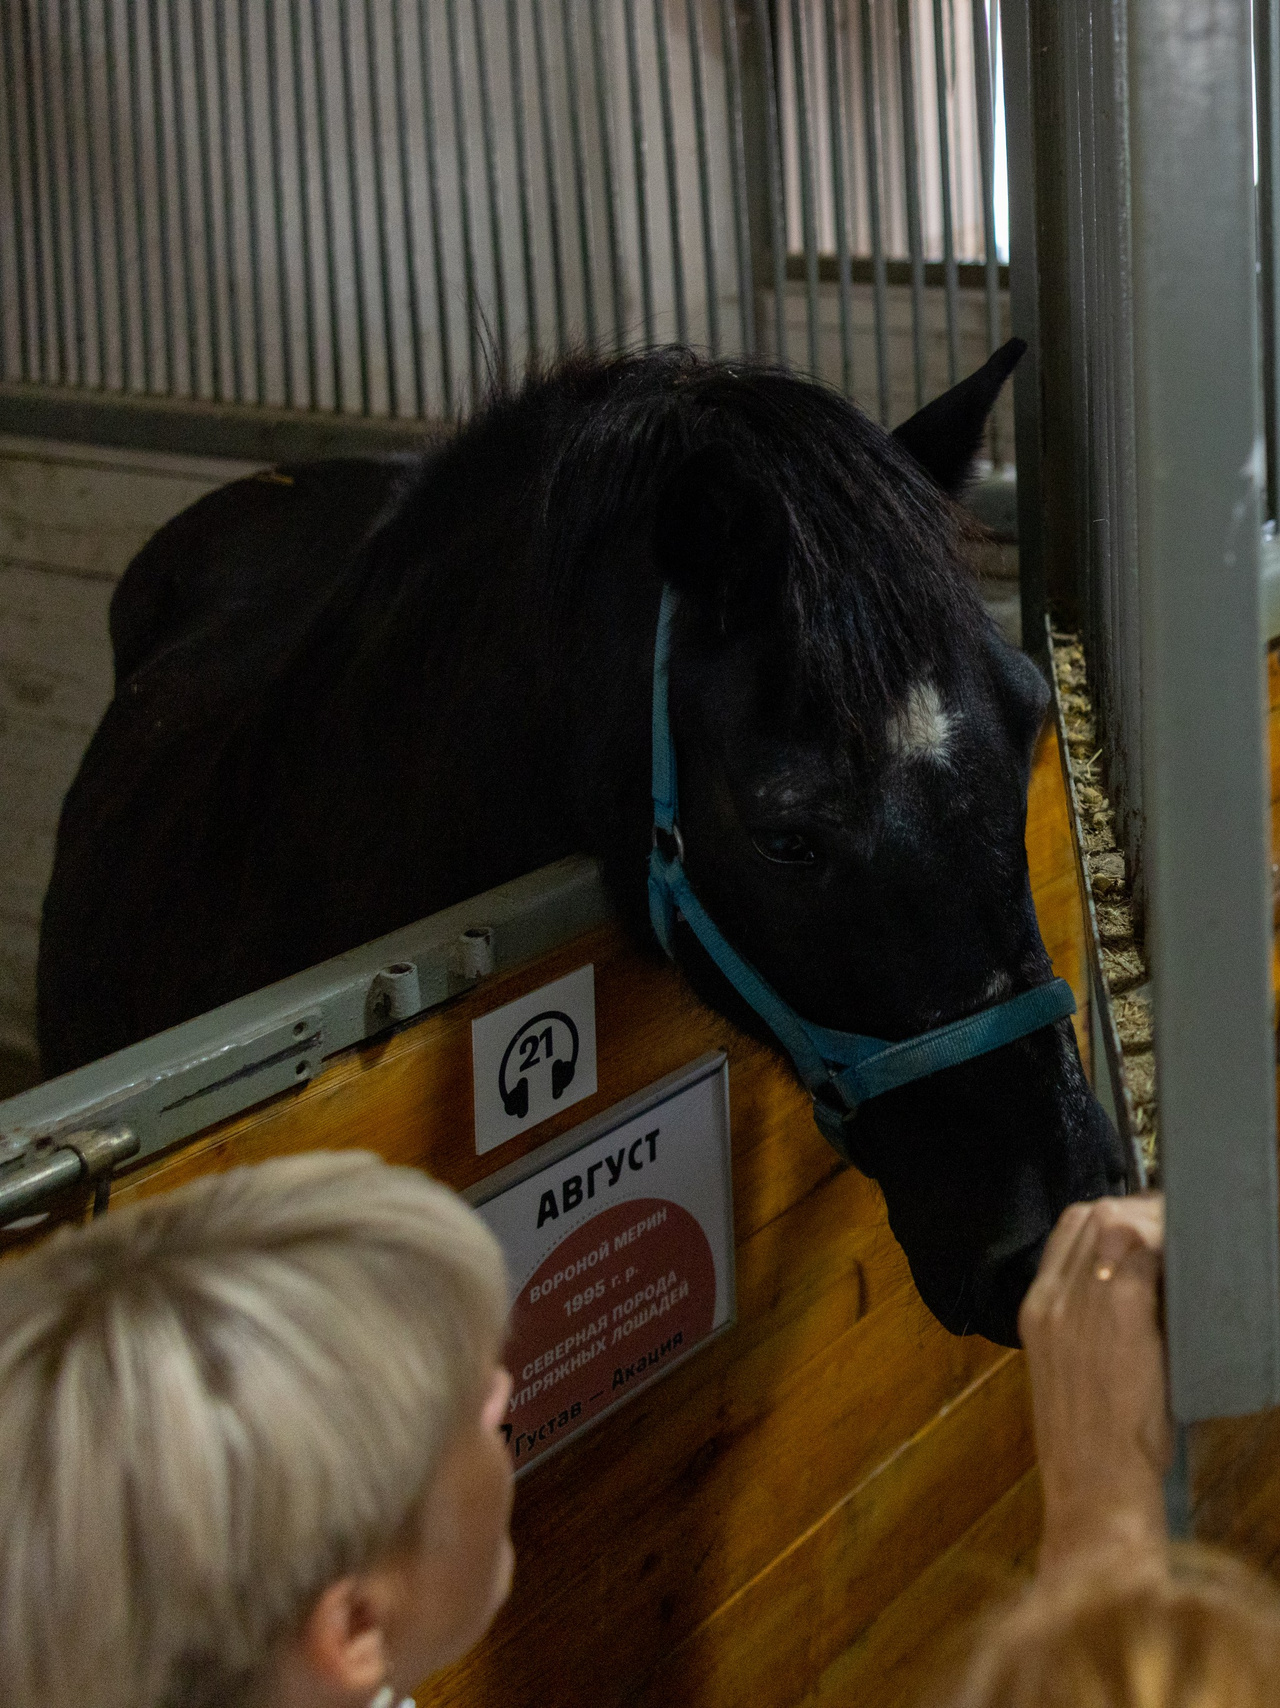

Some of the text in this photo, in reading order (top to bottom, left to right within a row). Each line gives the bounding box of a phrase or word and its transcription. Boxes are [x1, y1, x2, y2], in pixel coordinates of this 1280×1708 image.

[519, 1026, 554, 1071] 21
[537, 1128, 660, 1228] АВГУСТ
[529, 1207, 668, 1303] ВОРОНОЙ МЕРИН
[563, 1279, 605, 1317] 1995
[509, 1279, 689, 1413] УПРЯЖНЫХ ЛОШАДЕЙ
[522, 1270, 678, 1380] СЕВЕРНАЯ ПОРОДА
[514, 1402, 582, 1458] Густав
[612, 1331, 684, 1390] Акация
